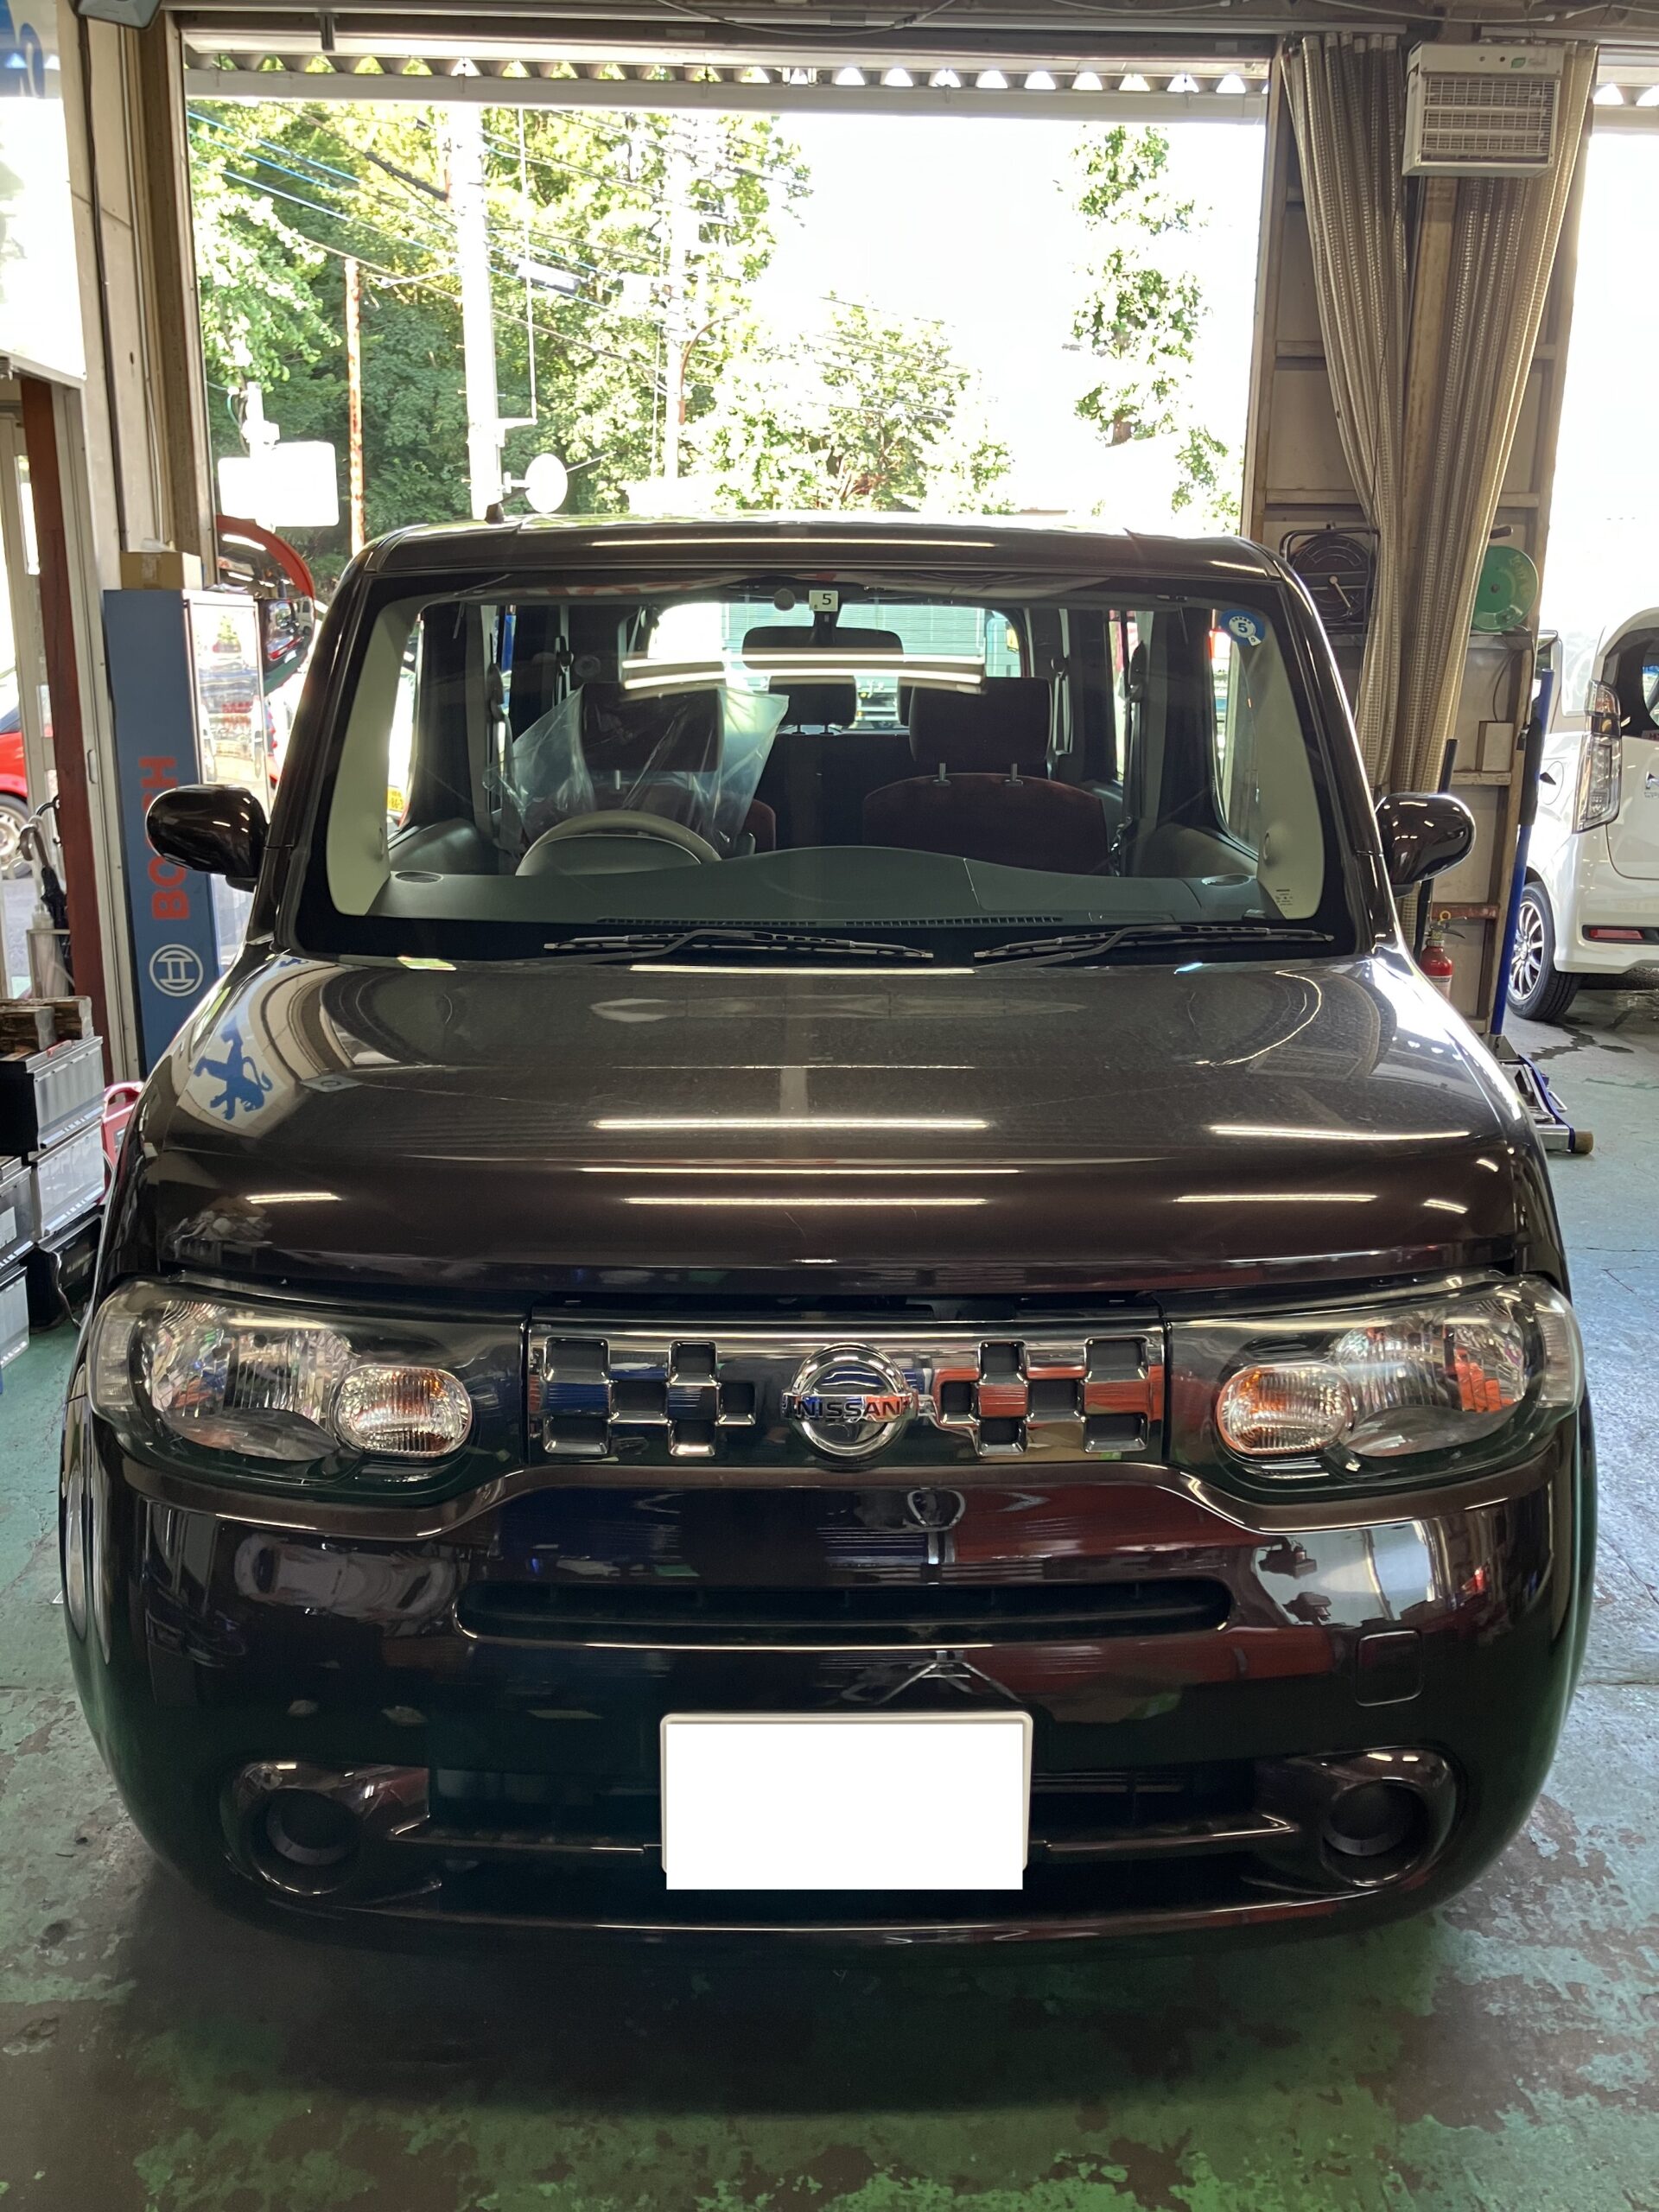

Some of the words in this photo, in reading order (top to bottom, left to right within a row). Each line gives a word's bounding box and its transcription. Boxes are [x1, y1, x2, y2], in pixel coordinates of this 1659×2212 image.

[822, 593, 831, 605] 5
[1237, 622, 1248, 633] 5
[138, 756, 190, 920] BOH
[797, 1400, 901, 1418] NISSAN
